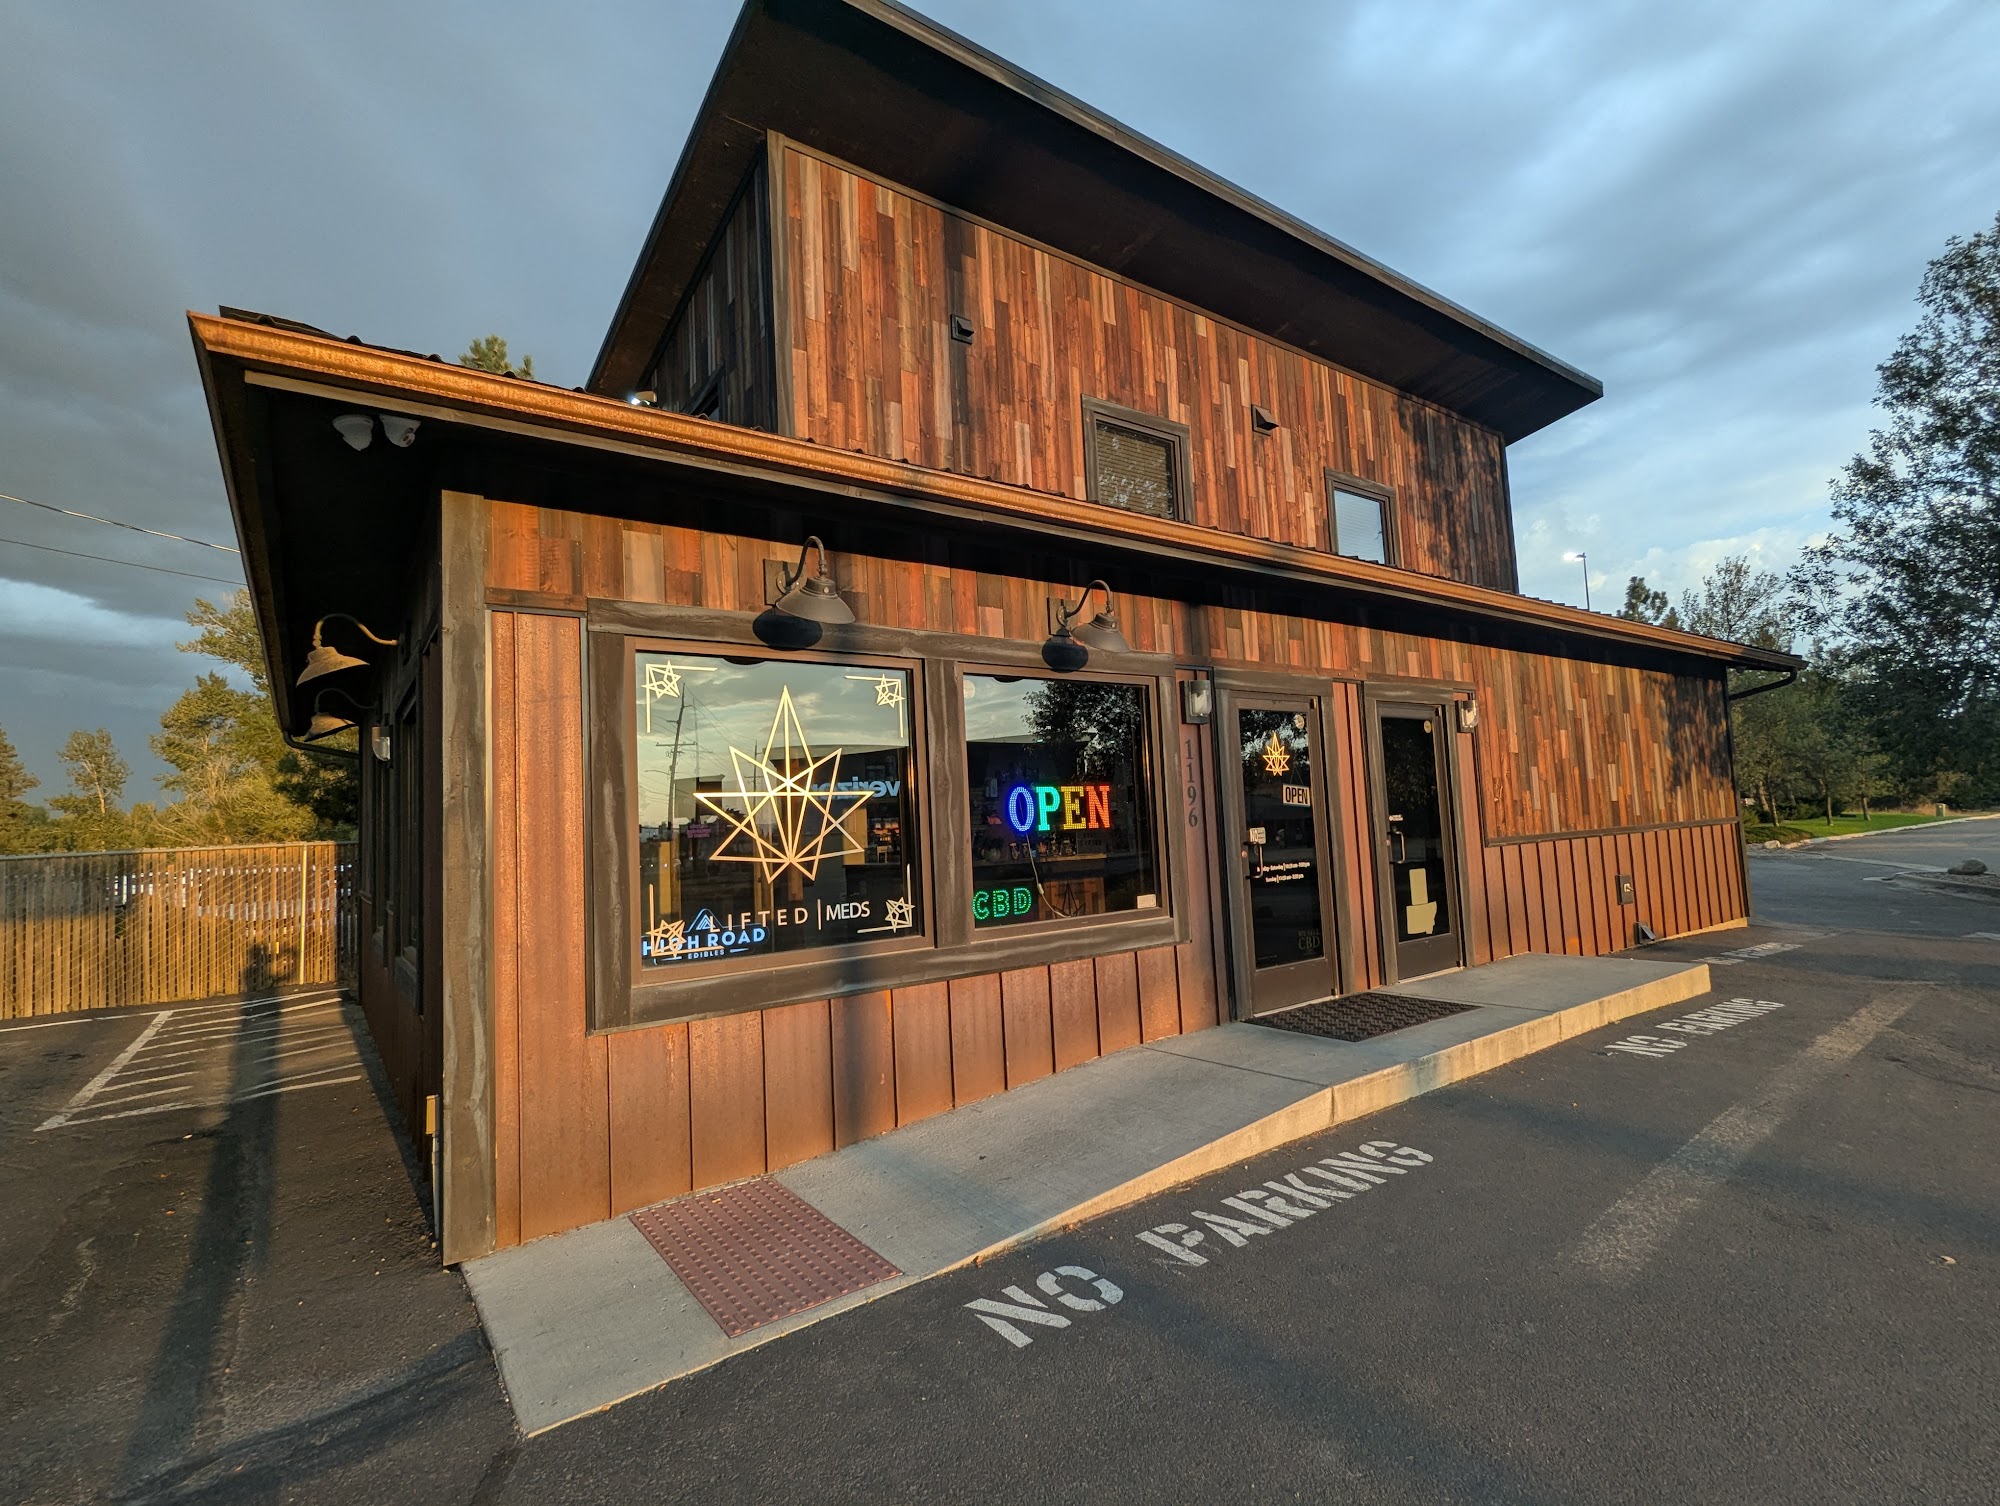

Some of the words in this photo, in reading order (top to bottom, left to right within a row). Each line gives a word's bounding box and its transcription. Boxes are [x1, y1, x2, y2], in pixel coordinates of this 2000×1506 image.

[1184, 739, 1199, 828] 1196
[1285, 786, 1309, 805] OPEN
[1008, 785, 1111, 832] OPEN
[709, 907, 809, 933] LIFTED
[826, 900, 871, 921] MEDS
[971, 886, 1032, 920] CBD
[707, 927, 766, 947] ROAD
[1298, 936, 1320, 950] CBD
[687, 949, 725, 960] EDIBLES
[1604, 1035, 1688, 1058] NO
[1655, 998, 1786, 1036] PARKING
[963, 1265, 1124, 1348] NO
[1135, 1140, 1434, 1267] PARKING
